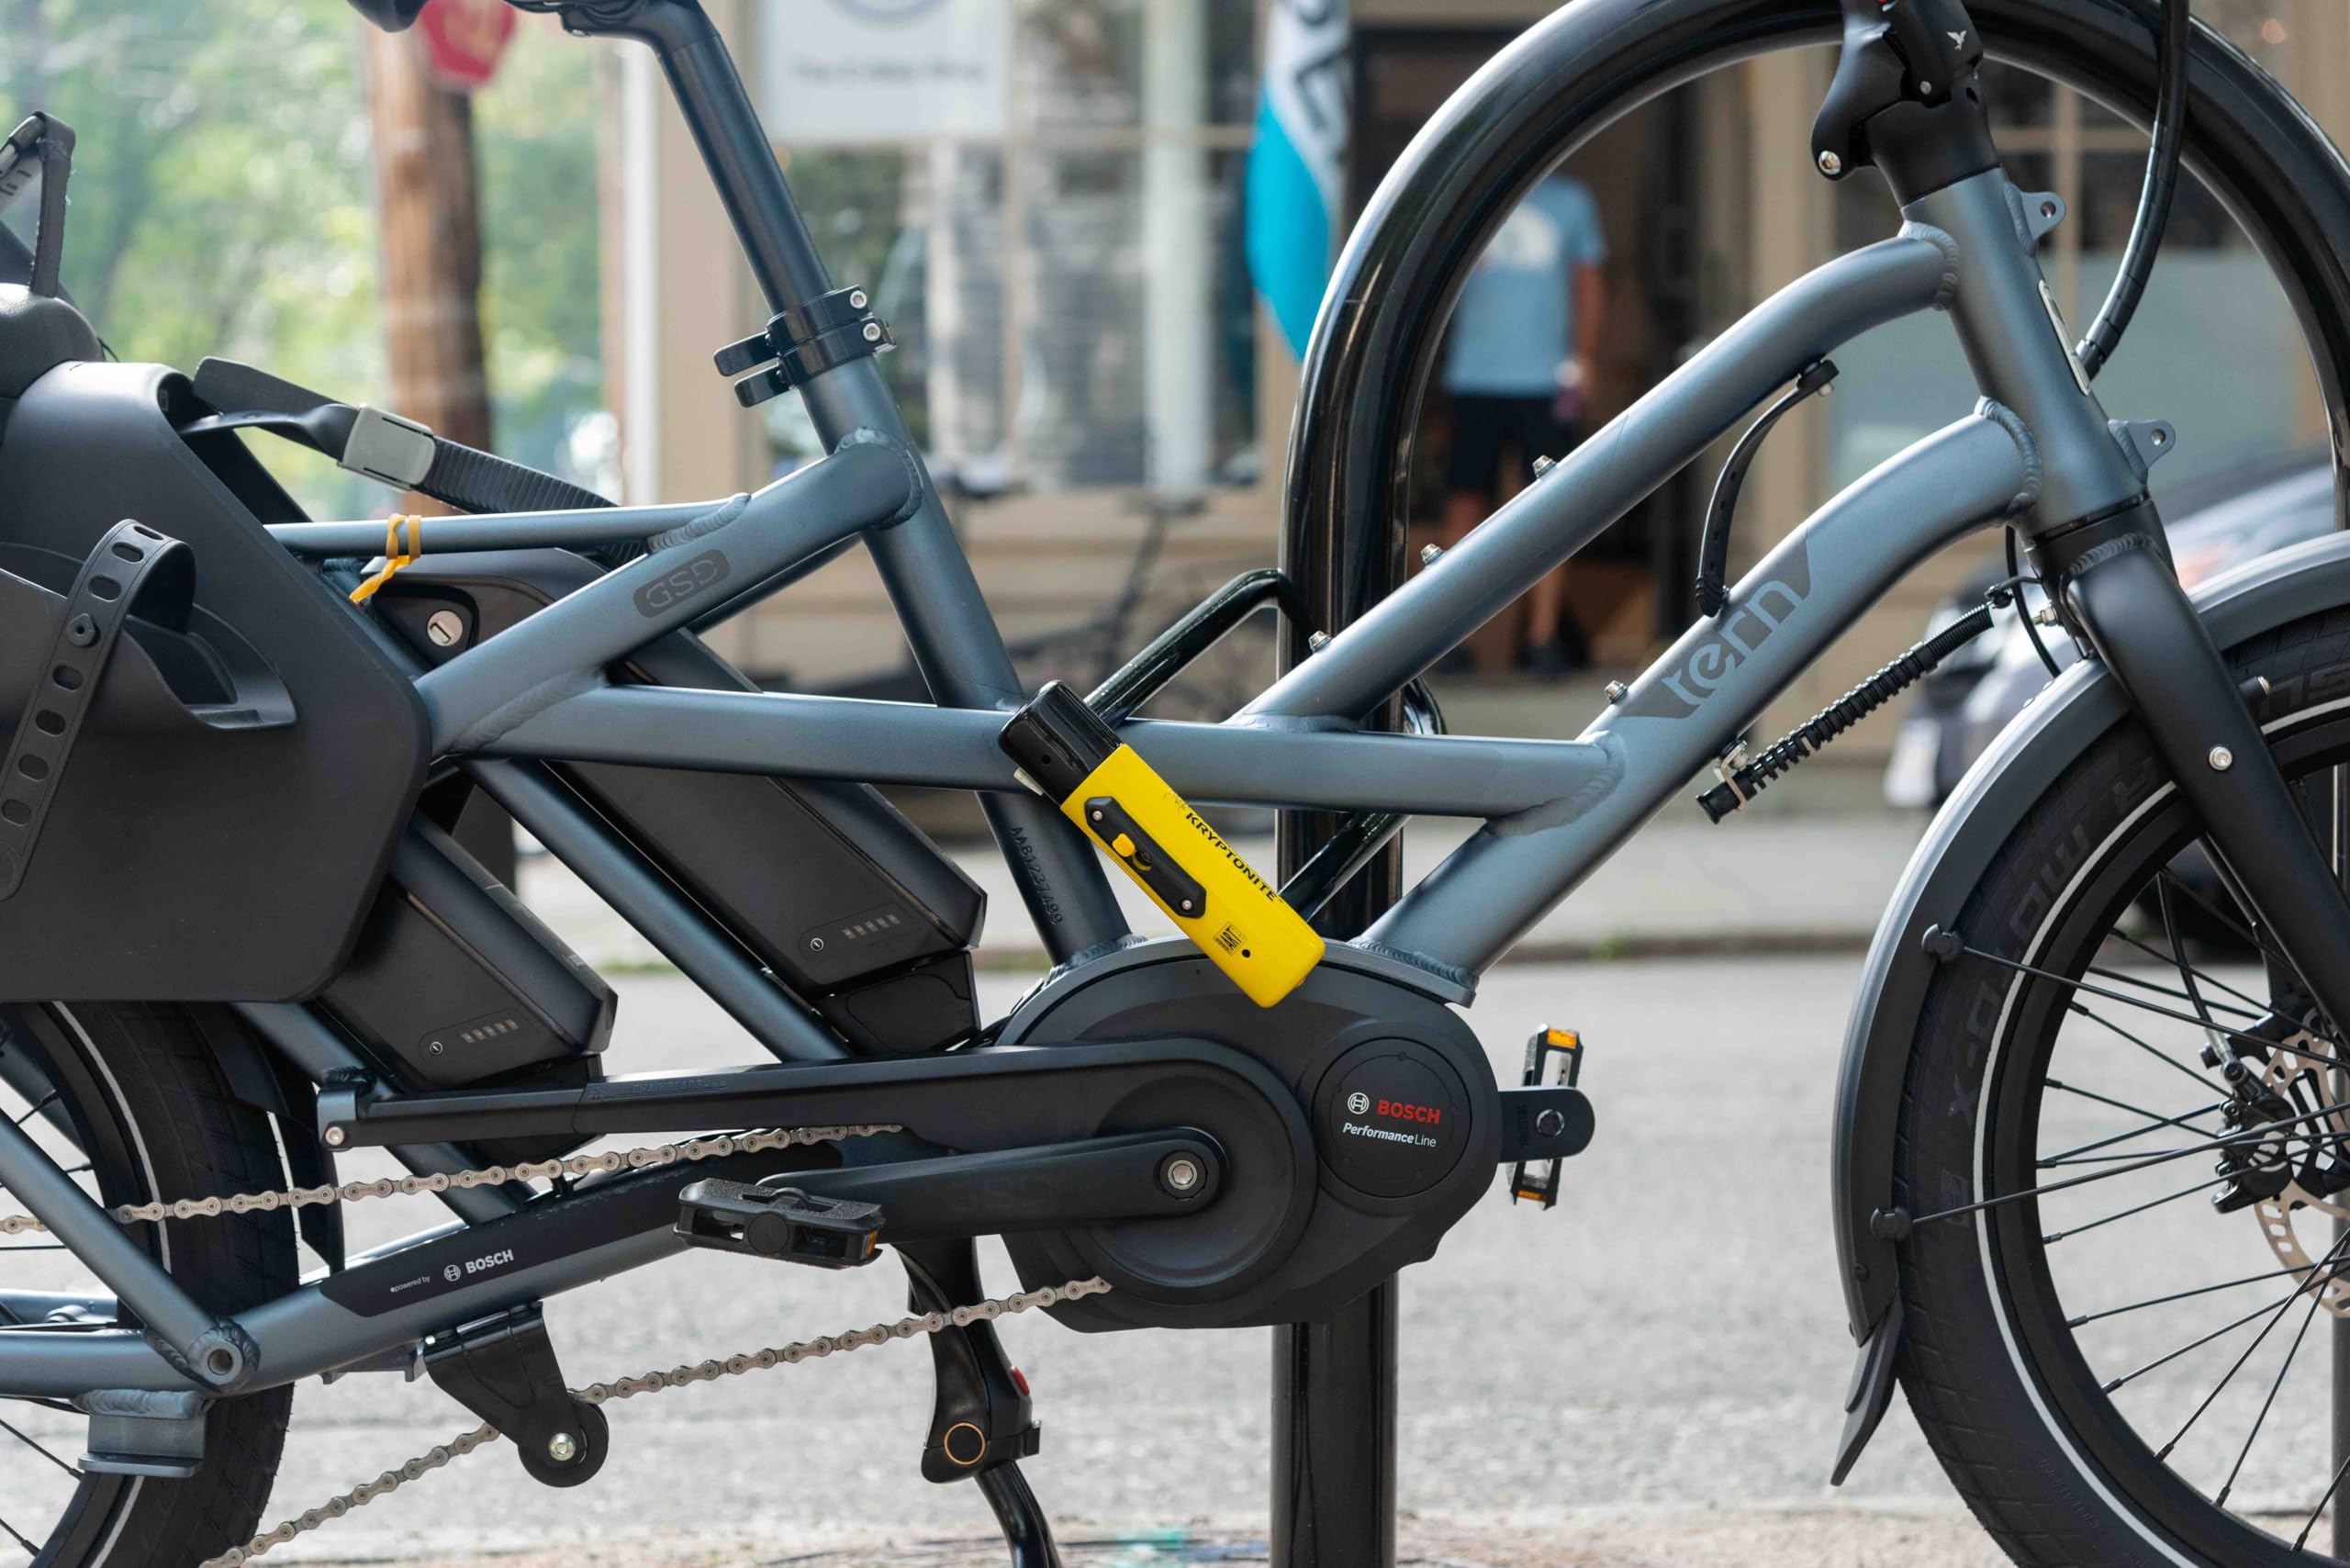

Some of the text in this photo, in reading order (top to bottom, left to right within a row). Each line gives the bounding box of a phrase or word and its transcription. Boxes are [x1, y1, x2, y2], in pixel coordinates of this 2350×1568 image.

[645, 559, 717, 608] GSD
[1185, 812, 1278, 902] KRYPTONITE
[1378, 1100, 1440, 1125] BOSCH
[464, 1249, 515, 1274] BOSCH
